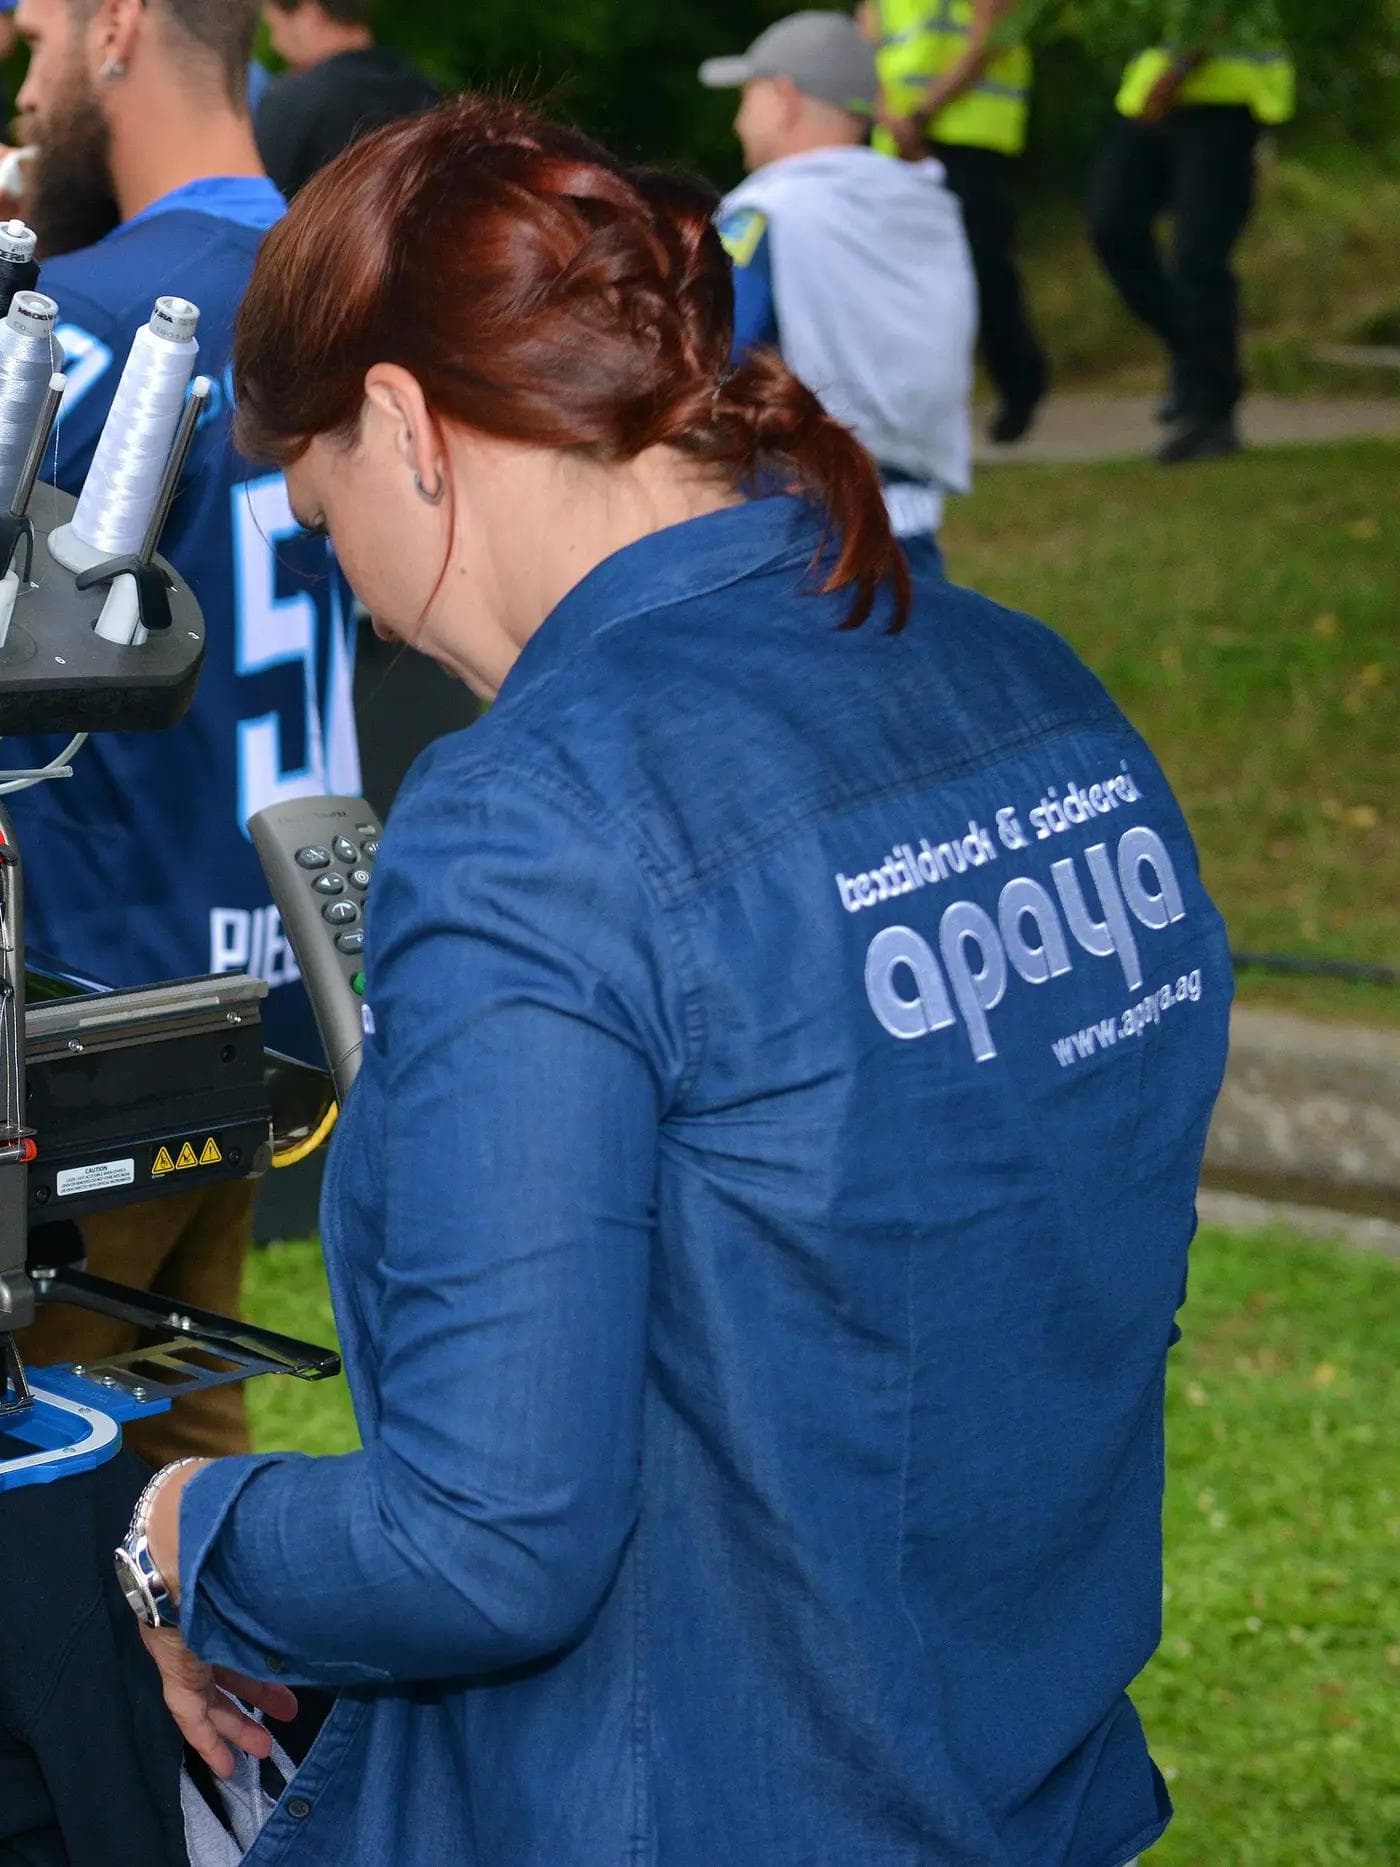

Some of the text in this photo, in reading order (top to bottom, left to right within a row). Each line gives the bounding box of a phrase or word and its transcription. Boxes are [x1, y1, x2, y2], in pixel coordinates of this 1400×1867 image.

[835, 820, 999, 913] textildruck
[995, 806, 1030, 850] &
[864, 826, 1186, 1063] apaya
[85, 1166, 108, 1175] CAUTION
